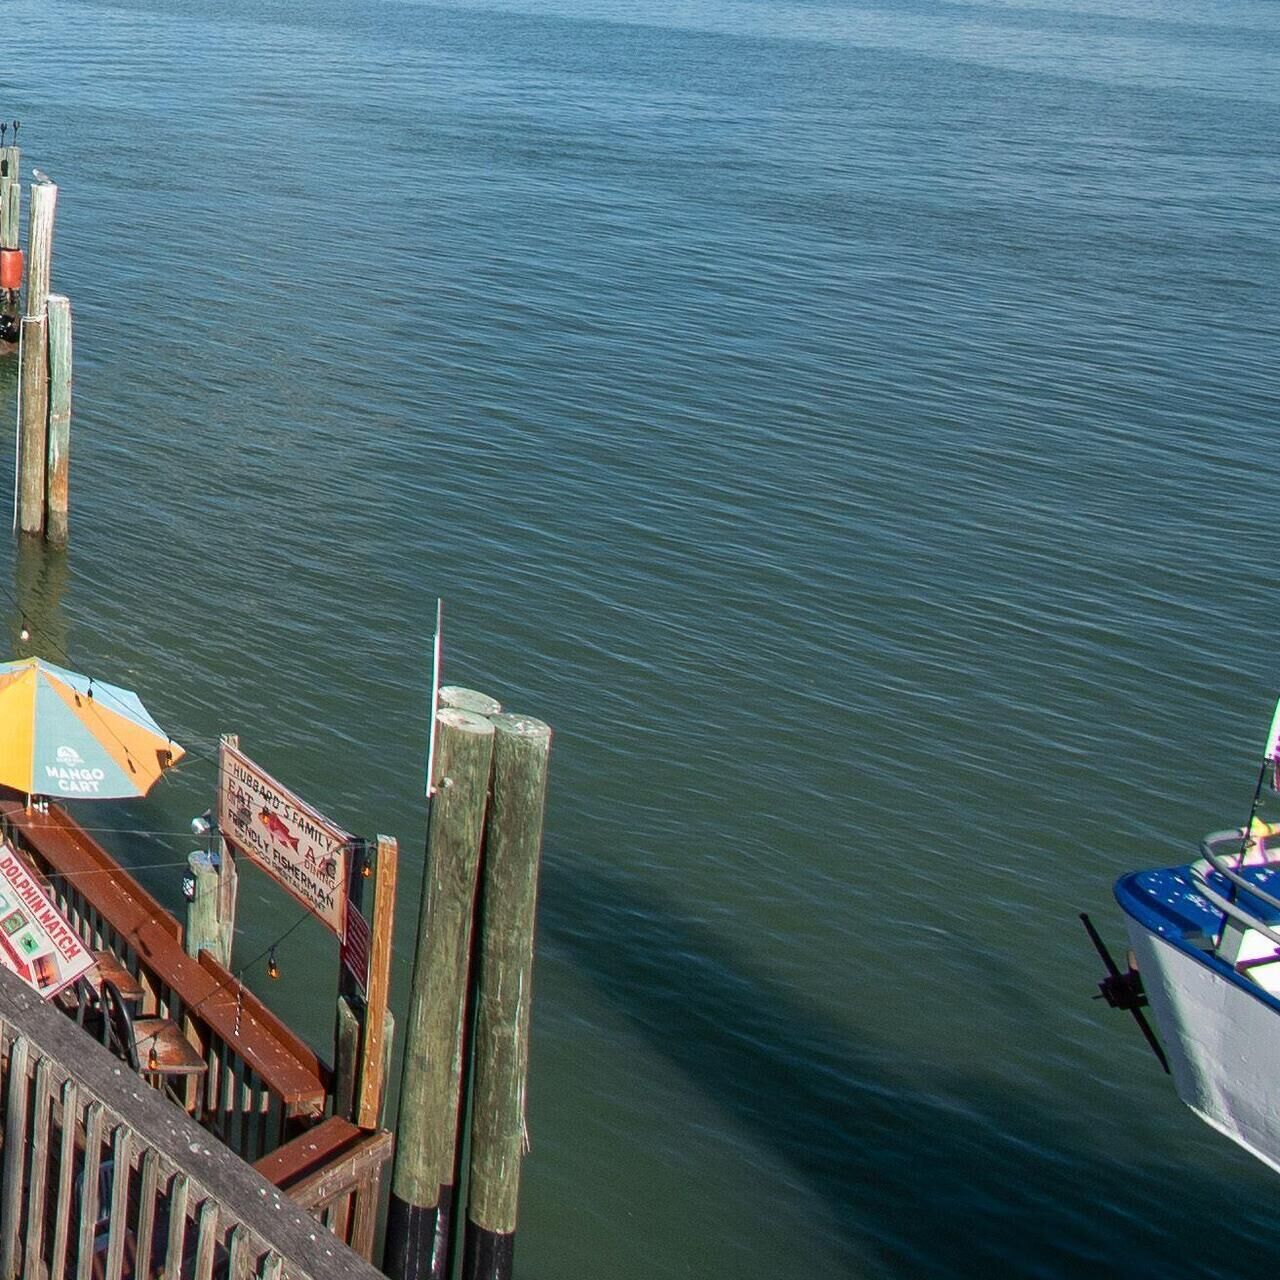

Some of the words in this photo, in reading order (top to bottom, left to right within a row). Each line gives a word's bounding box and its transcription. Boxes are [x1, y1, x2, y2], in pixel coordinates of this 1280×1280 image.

[45, 766, 104, 780] MANGO
[58, 779, 99, 792] CART
[228, 777, 253, 809] EAT
[292, 811, 332, 851] FAMILY
[228, 809, 269, 853] FRIENDLY
[273, 847, 334, 910] FISHERMAN
[235, 828, 271, 866] SEAFOOD
[271, 861, 327, 913] RESTAURANT
[304, 859, 335, 890] DINING
[0, 856, 45, 914] DOLPHIN
[39, 908, 81, 961] WATCH
